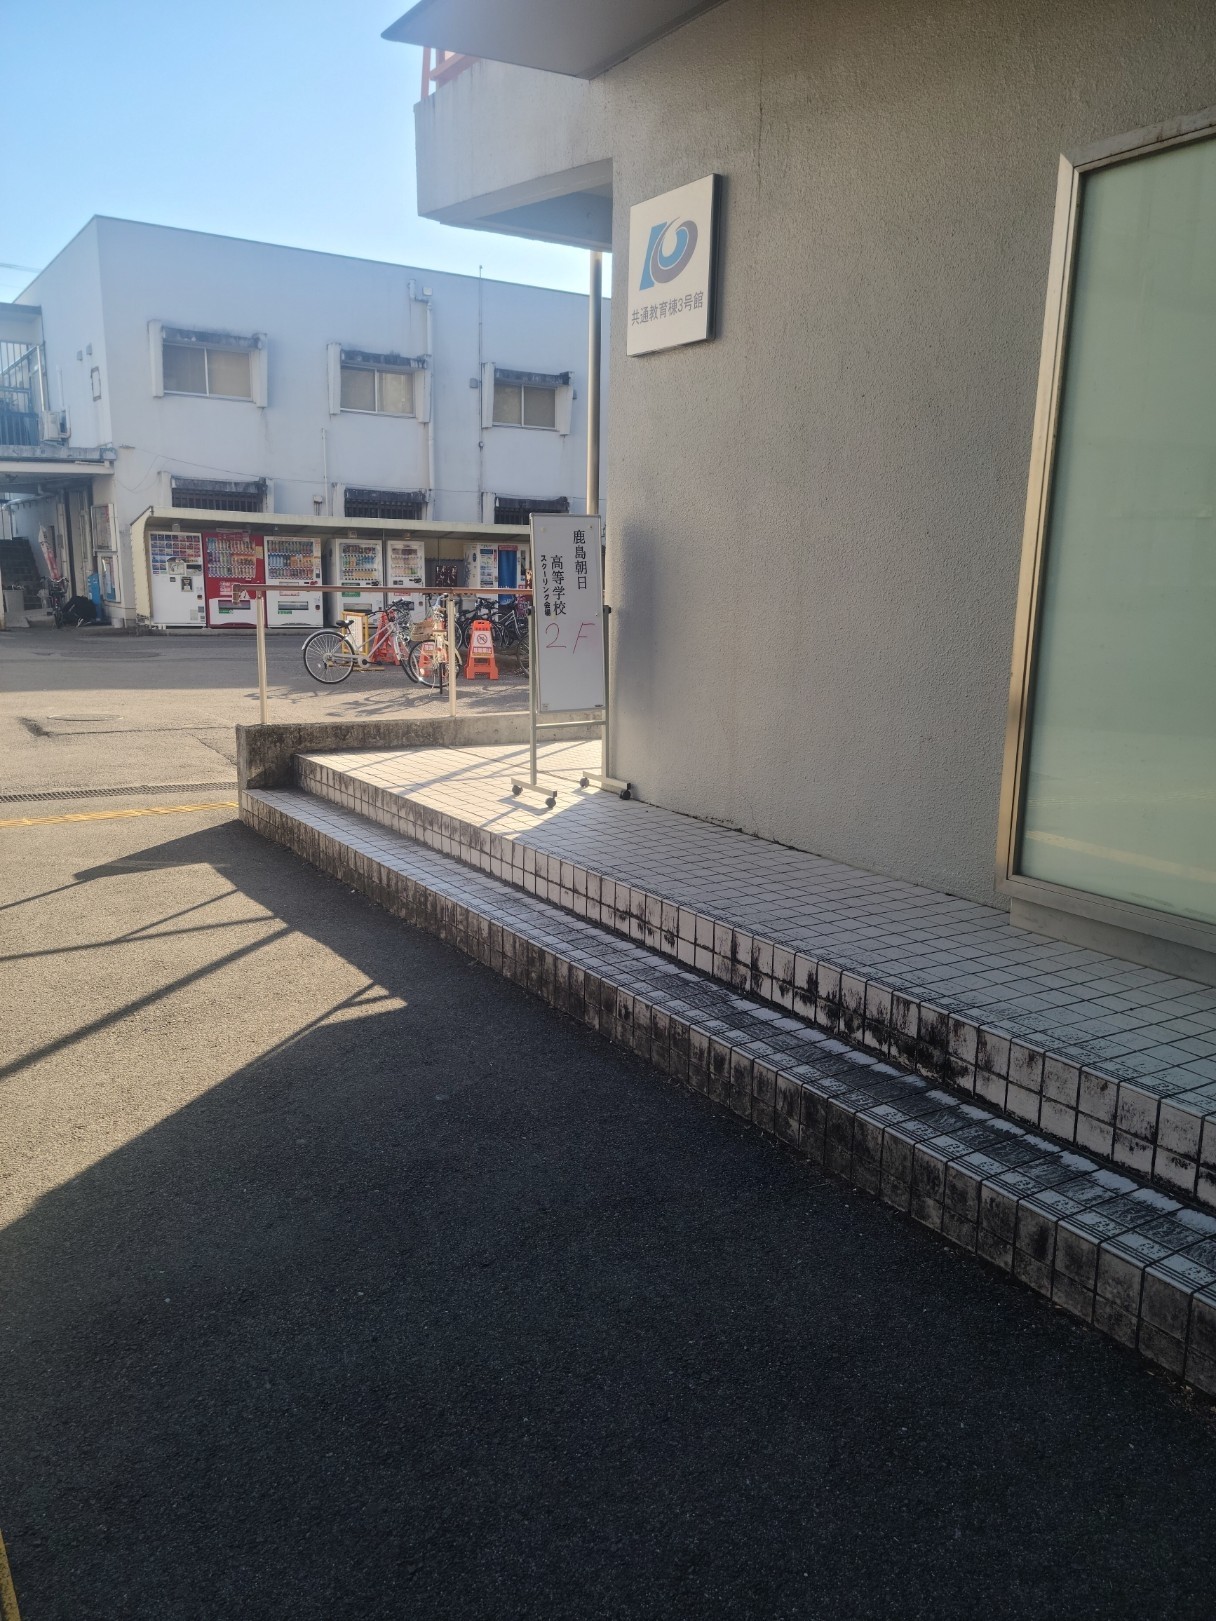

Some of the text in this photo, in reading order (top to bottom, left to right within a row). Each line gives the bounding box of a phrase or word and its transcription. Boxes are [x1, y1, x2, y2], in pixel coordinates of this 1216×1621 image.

[631, 290, 704, 327] 共通教育棟3号館
[550, 554, 567, 616] 高等学校
[573, 529, 588, 590] 鹿島朝日
